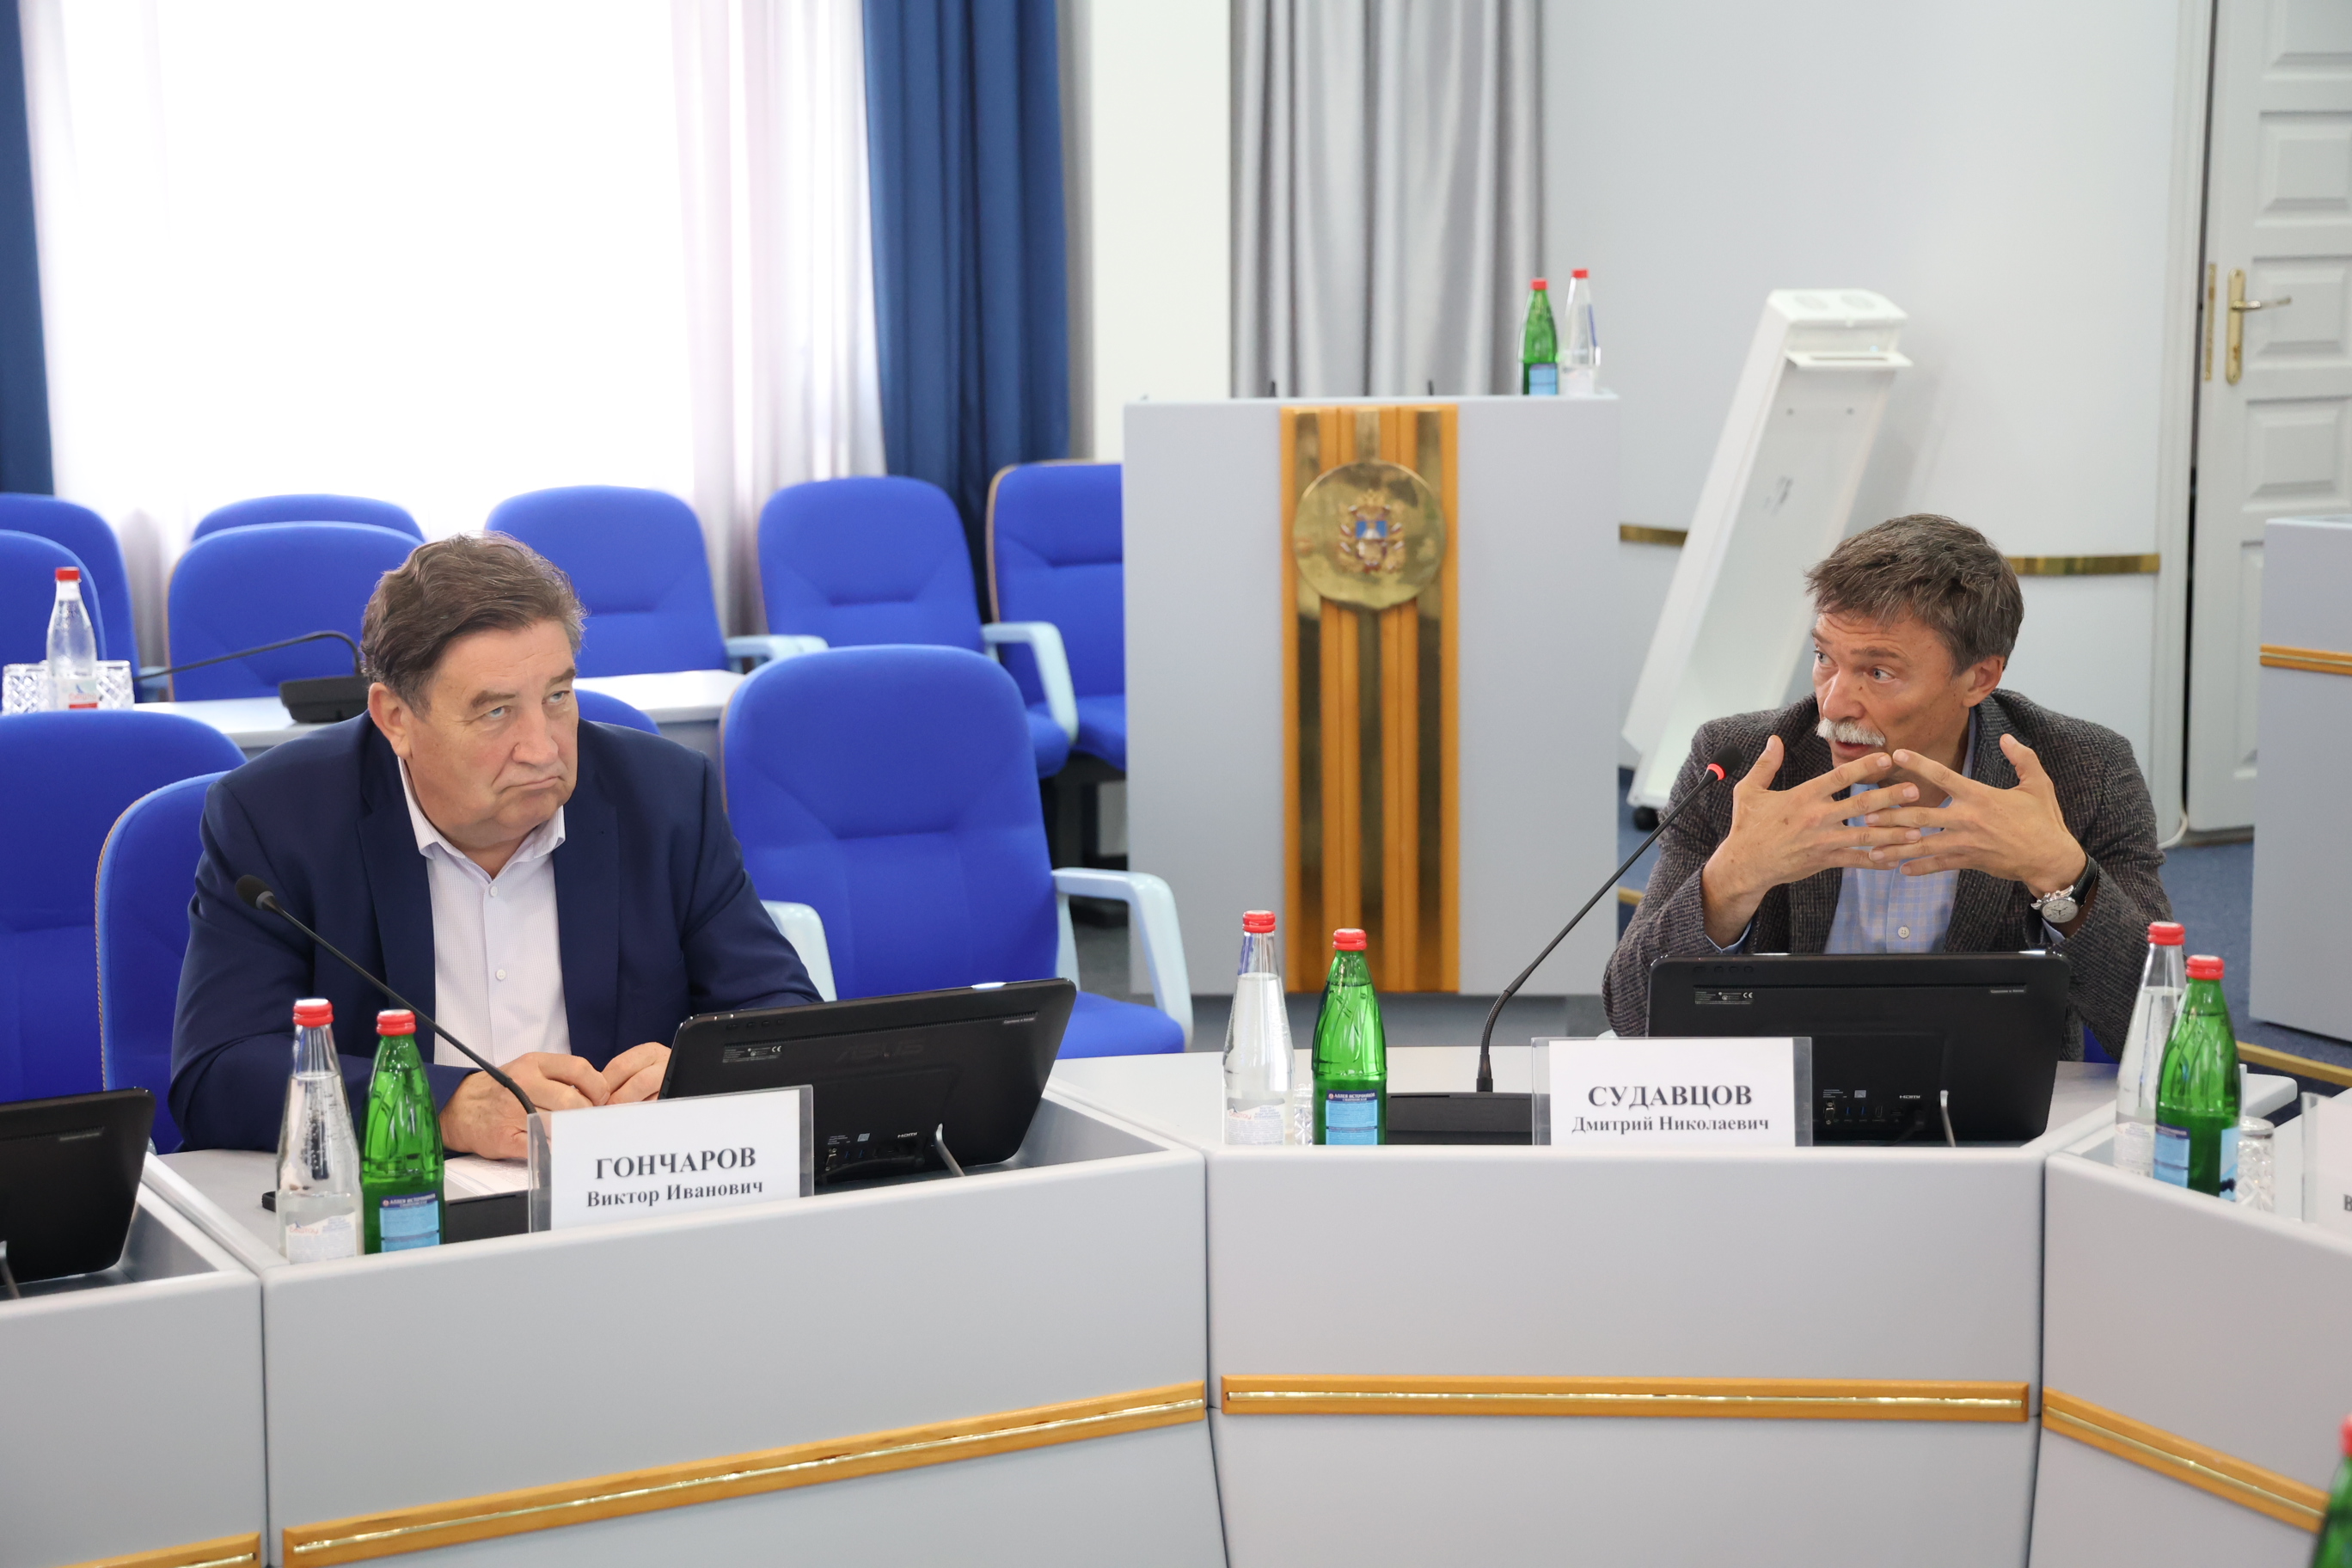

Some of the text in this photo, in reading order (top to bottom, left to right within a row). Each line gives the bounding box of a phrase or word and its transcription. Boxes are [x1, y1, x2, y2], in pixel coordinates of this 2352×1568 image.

[1587, 1085, 1753, 1111] СУДАВЦОВ
[1571, 1116, 1770, 1136] Дмитрий Николаевич
[595, 1146, 757, 1180] ГОНЧАРОВ
[587, 1181, 763, 1208] Виктор Иванович
